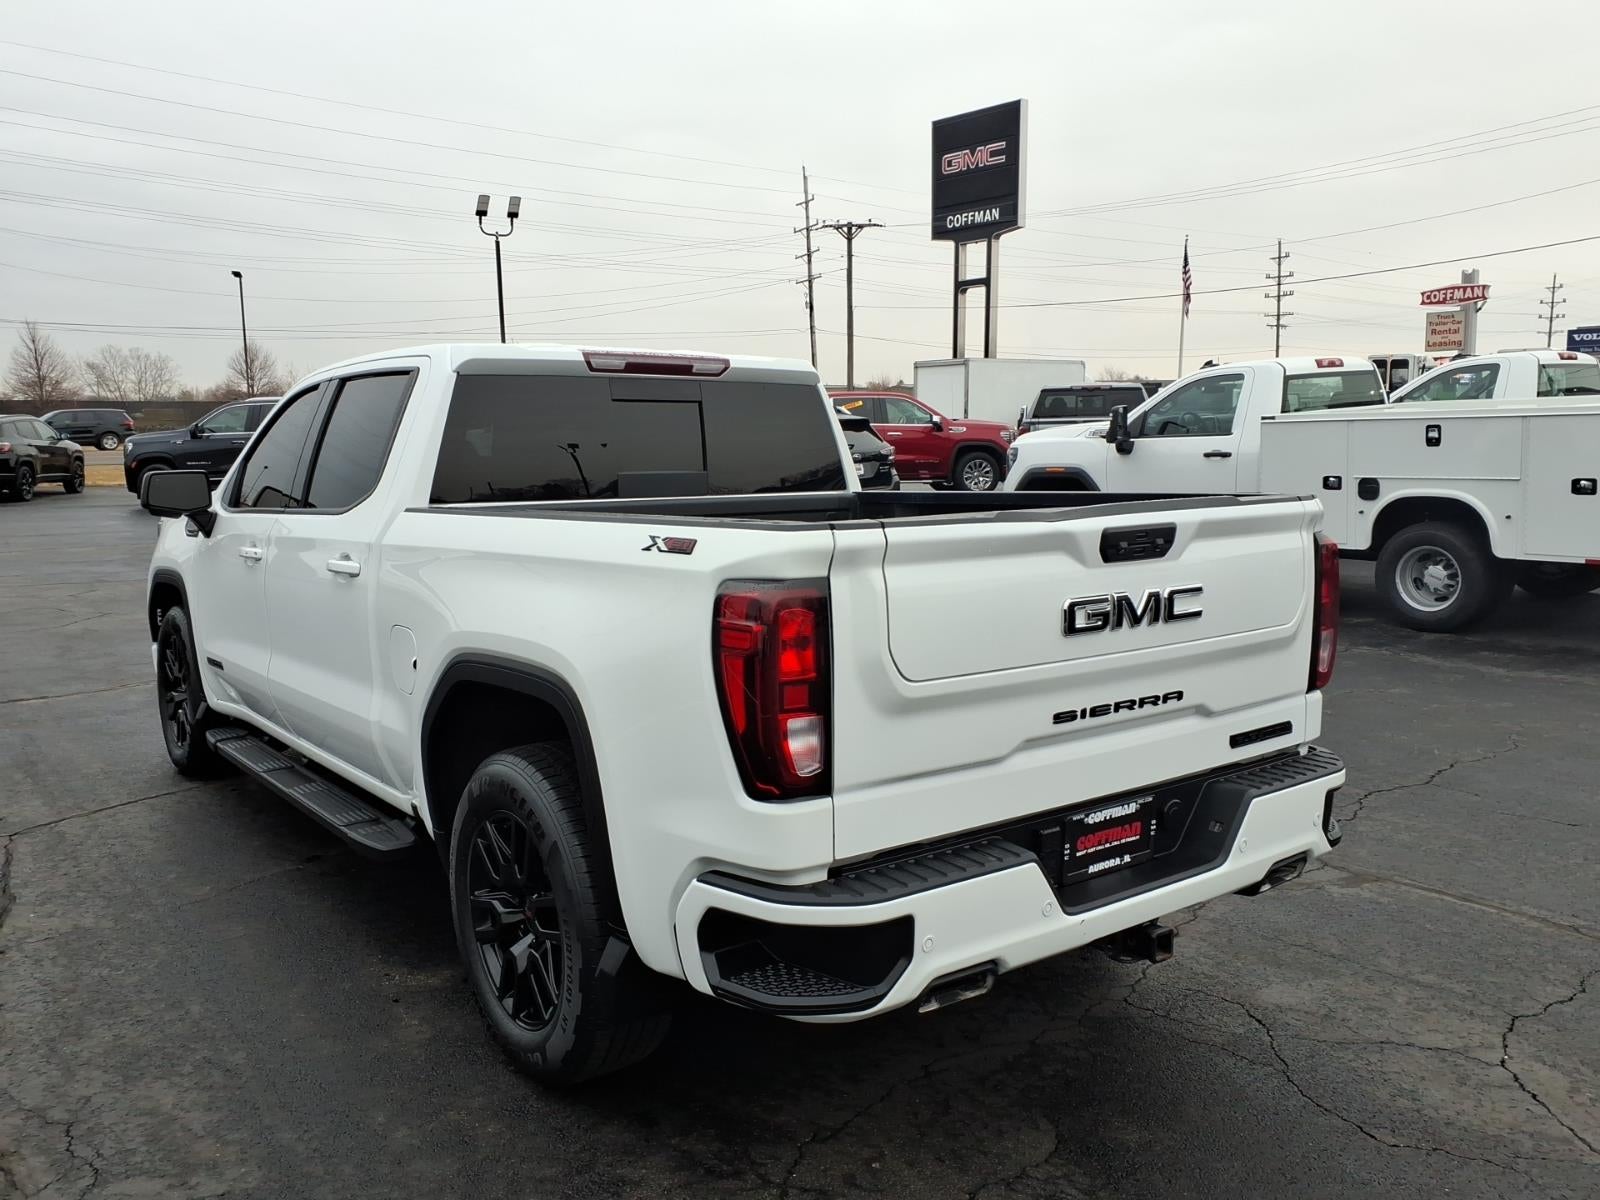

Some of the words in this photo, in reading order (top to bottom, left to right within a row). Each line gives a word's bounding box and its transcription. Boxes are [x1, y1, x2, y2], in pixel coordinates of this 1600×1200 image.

[942, 141, 1006, 175] GMC
[946, 207, 1000, 228] COFFMAN
[1423, 286, 1483, 303] COFFMAN
[1431, 327, 1460, 336] Rental
[1427, 339, 1462, 348] Leasing
[1061, 583, 1203, 637] GMC
[1053, 690, 1184, 724] SIERRA
